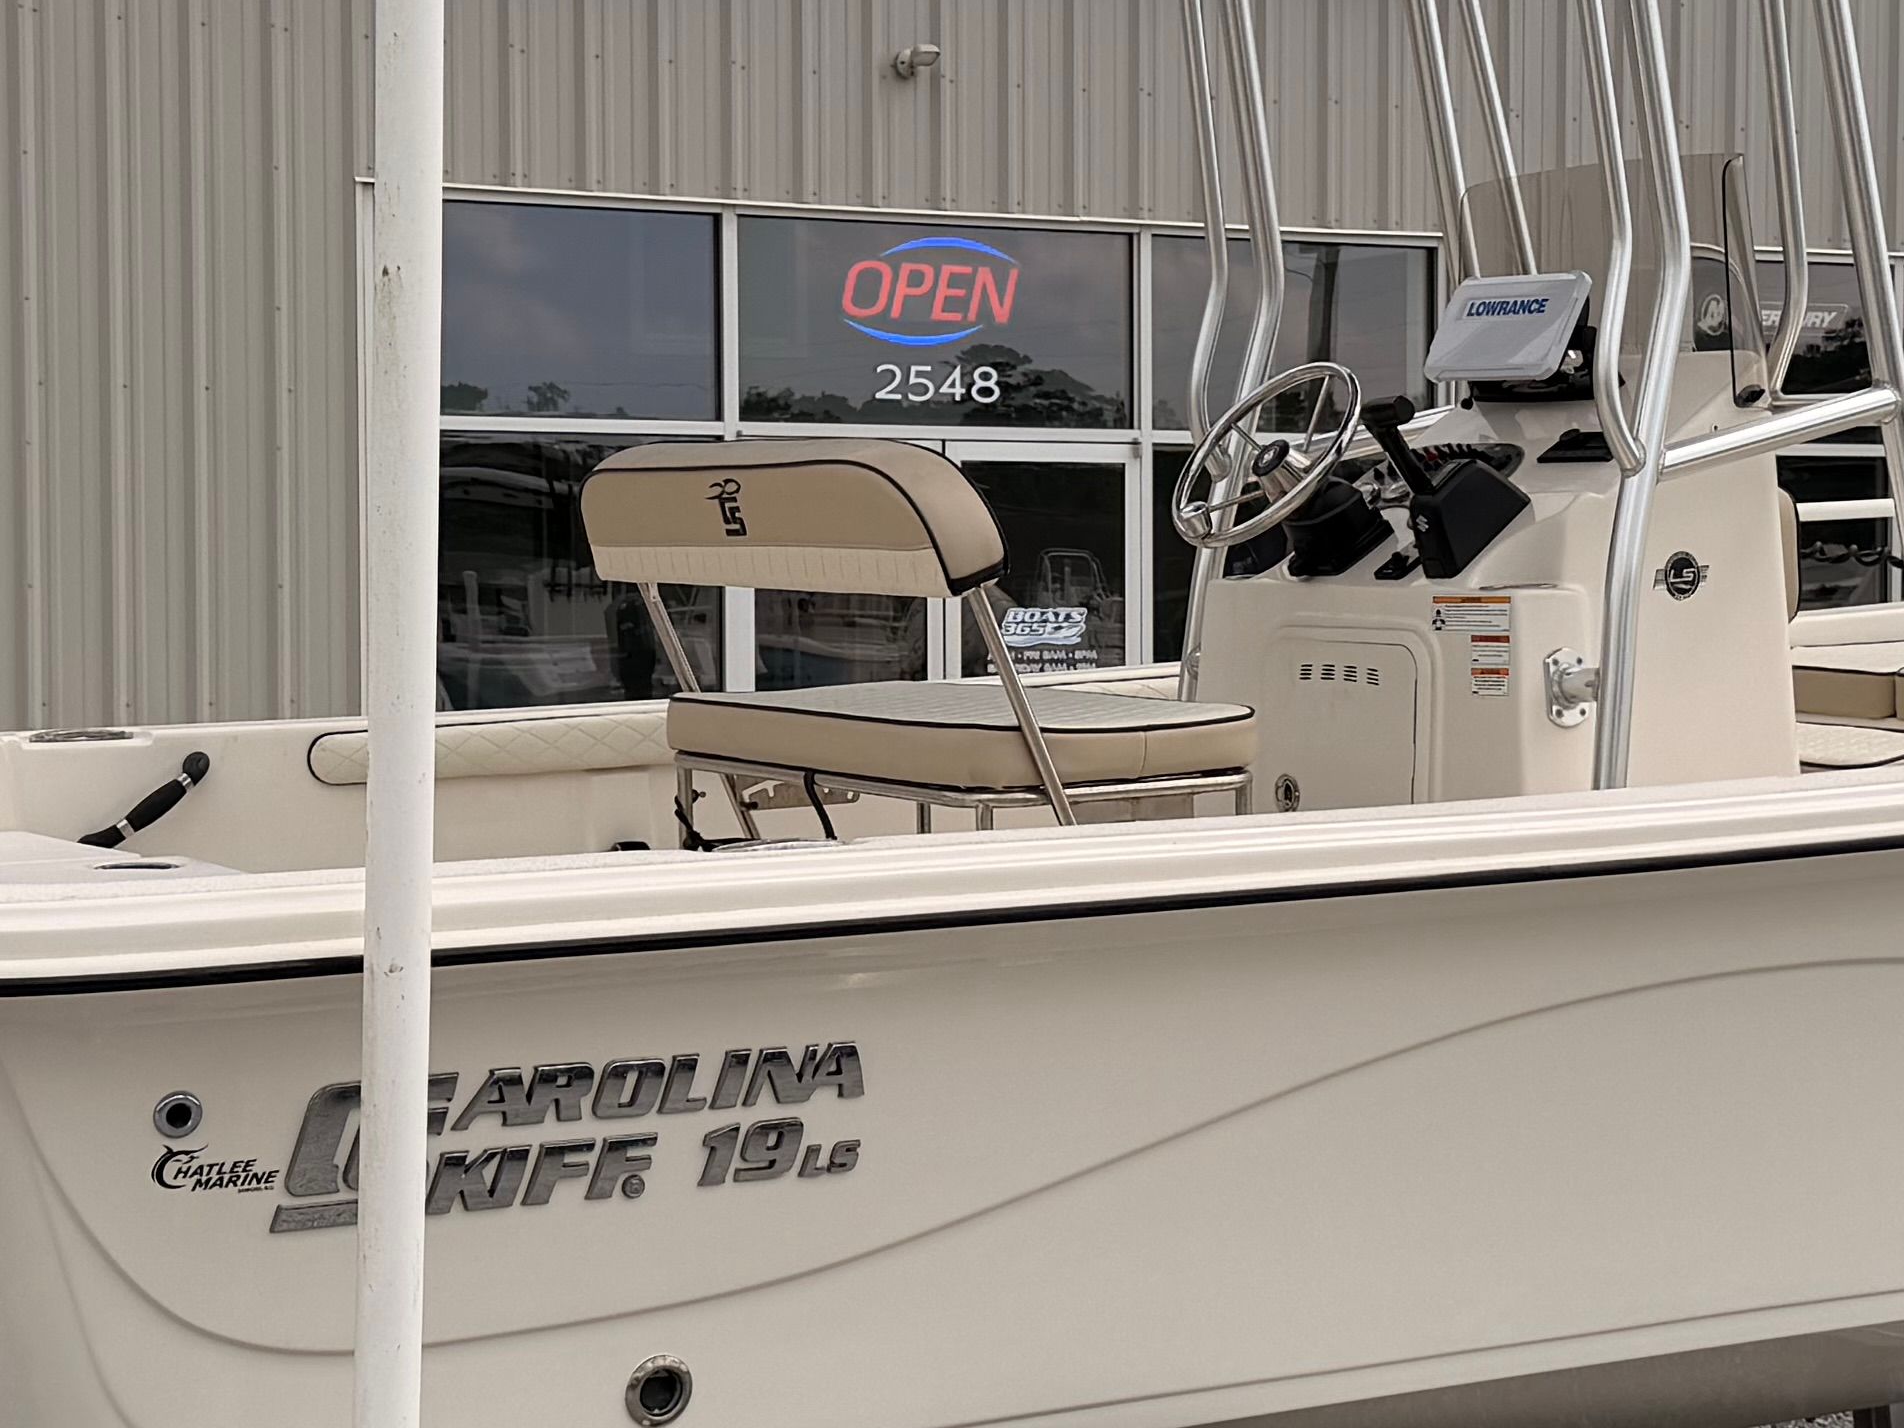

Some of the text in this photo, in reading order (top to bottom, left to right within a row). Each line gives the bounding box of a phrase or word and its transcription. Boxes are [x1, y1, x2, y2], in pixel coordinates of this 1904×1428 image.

[842, 260, 1020, 324] OPEN
[1466, 298, 1550, 316] LOWRANCE
[874, 363, 1001, 404] 2548
[1006, 610, 1084, 623] BOATS
[191, 1170, 280, 1192] MARINE
[341, 1132, 658, 1218] KIFF
